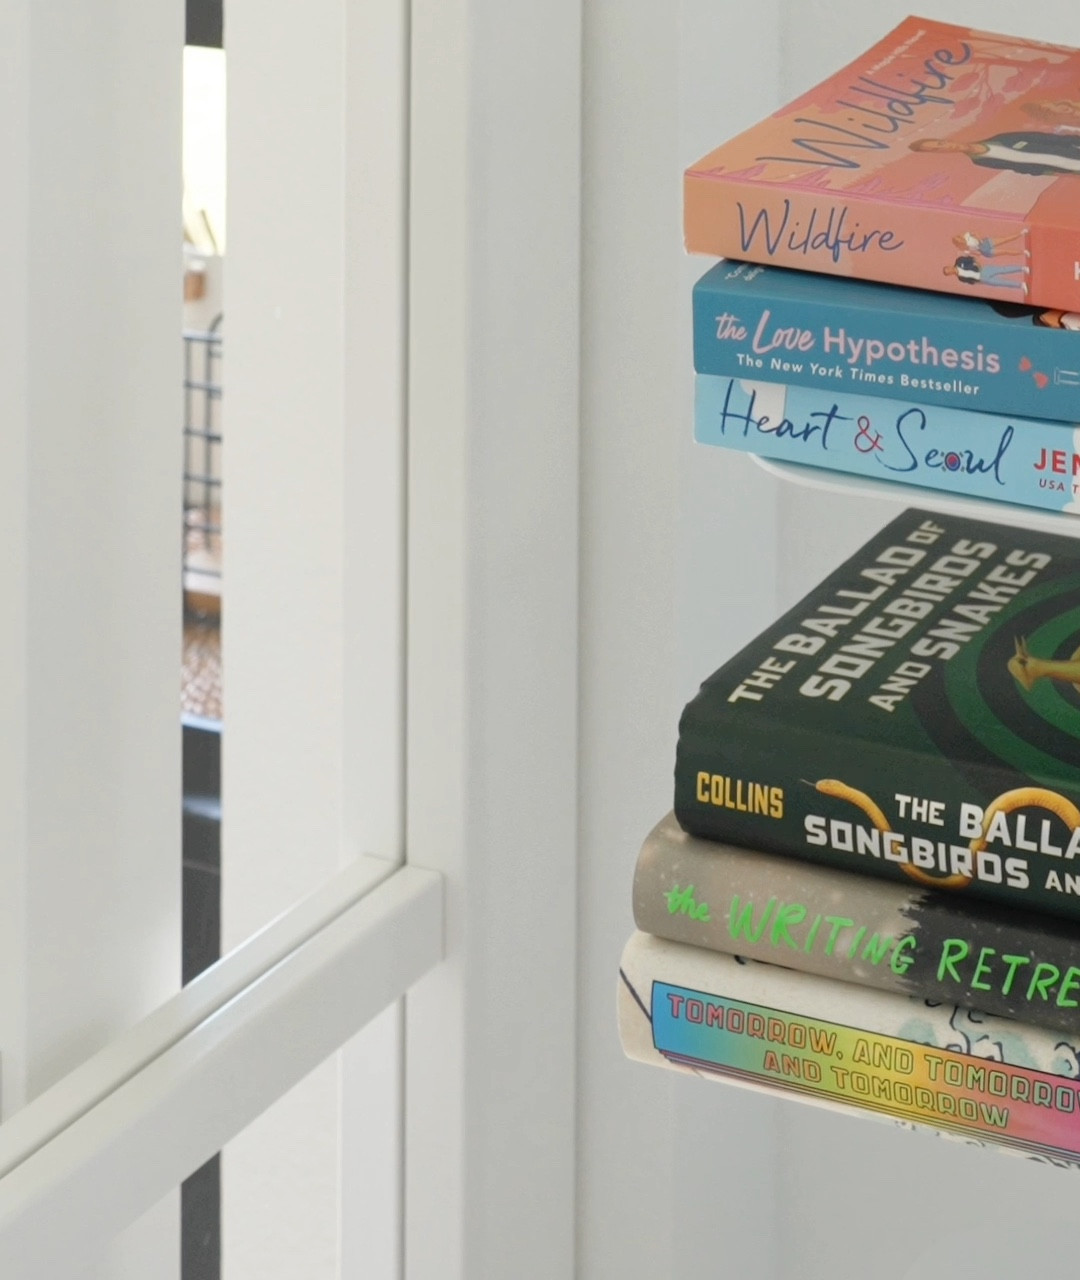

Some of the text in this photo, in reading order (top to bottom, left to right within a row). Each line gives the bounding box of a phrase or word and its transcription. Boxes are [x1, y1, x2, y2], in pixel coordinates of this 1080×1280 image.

[755, 40, 973, 170] Wildfire
[735, 198, 905, 264] Wildfire
[715, 309, 1002, 374] the Love Hypothesis
[736, 353, 980, 396] The New York Times Bestseller
[719, 379, 854, 450] Heart
[854, 415, 885, 454] &
[1038, 478, 1066, 493] USA
[727, 519, 947, 704] THE BALLAD OF
[799, 538, 999, 702] SONGBIRDS
[868, 549, 1053, 713] AND SNAKES
[696, 770, 784, 820] COLLINS
[895, 793, 946, 827] THE
[804, 813, 1030, 890] SONGBIRDS
[664, 884, 711, 923] the
[727, 894, 918, 976] WRITING
[667, 993, 843, 1060] TOMORROW,
[853, 1038, 914, 1075] AND
[763, 1050, 1010, 1129] AND TOMORROW
